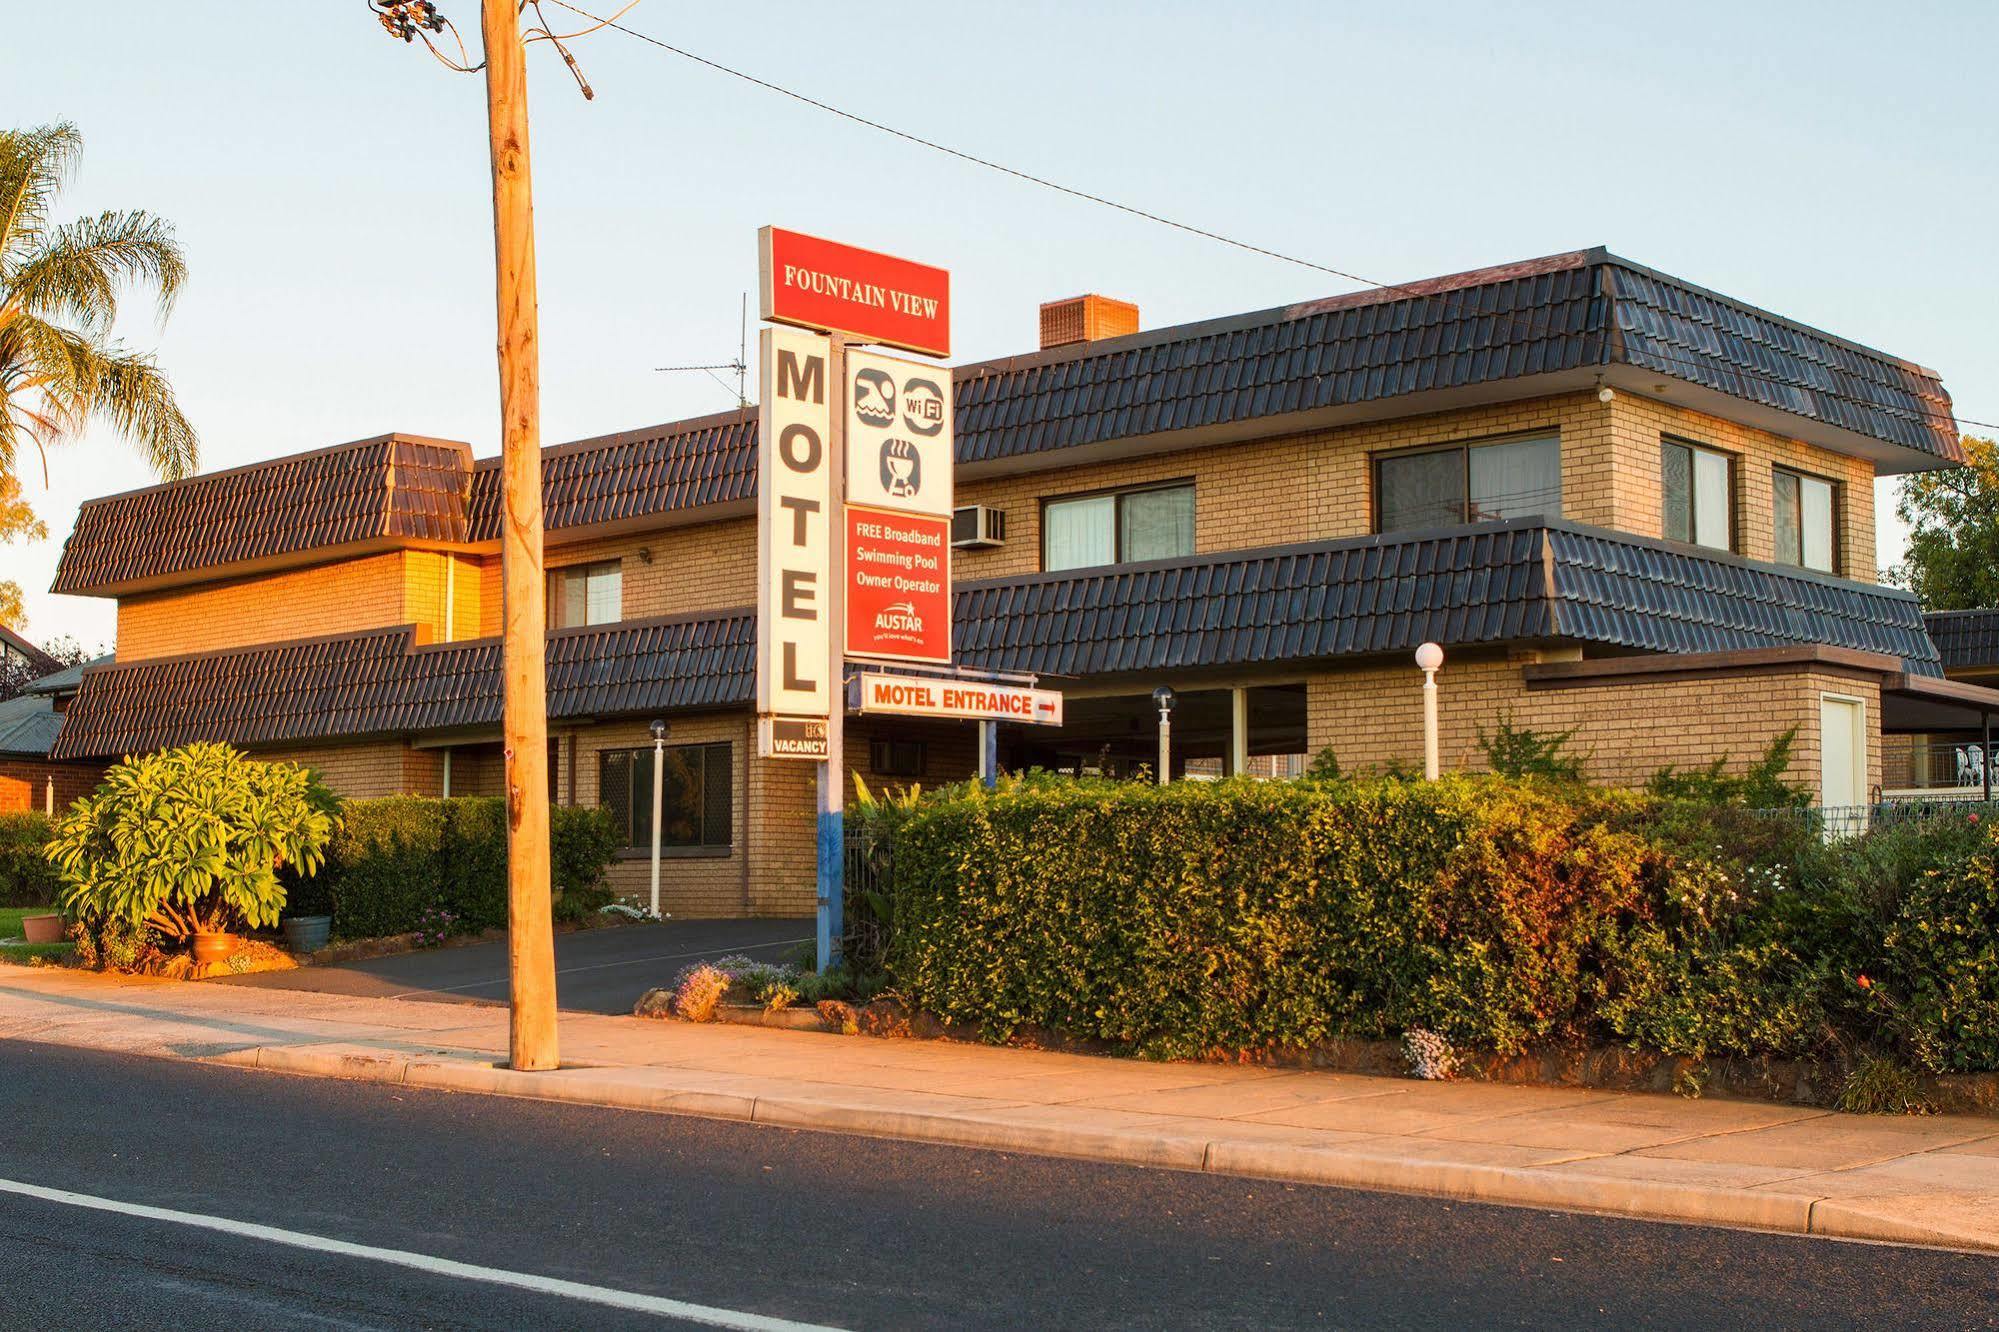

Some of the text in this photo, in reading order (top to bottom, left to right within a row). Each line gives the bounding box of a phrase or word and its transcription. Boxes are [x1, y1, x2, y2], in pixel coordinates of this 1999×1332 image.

[784, 264, 939, 320] FOUNTAIN VIEW
[777, 348, 825, 693] MOTEL
[856, 522, 941, 547] FREE Broadband
[856, 546, 938, 570] Swimming Pool
[856, 571, 940, 593] Owner Operator
[875, 613, 923, 632] AUSTAR
[874, 684, 1033, 714] MOTEL ENTRANCE
[774, 739, 827, 753] VACANCY
